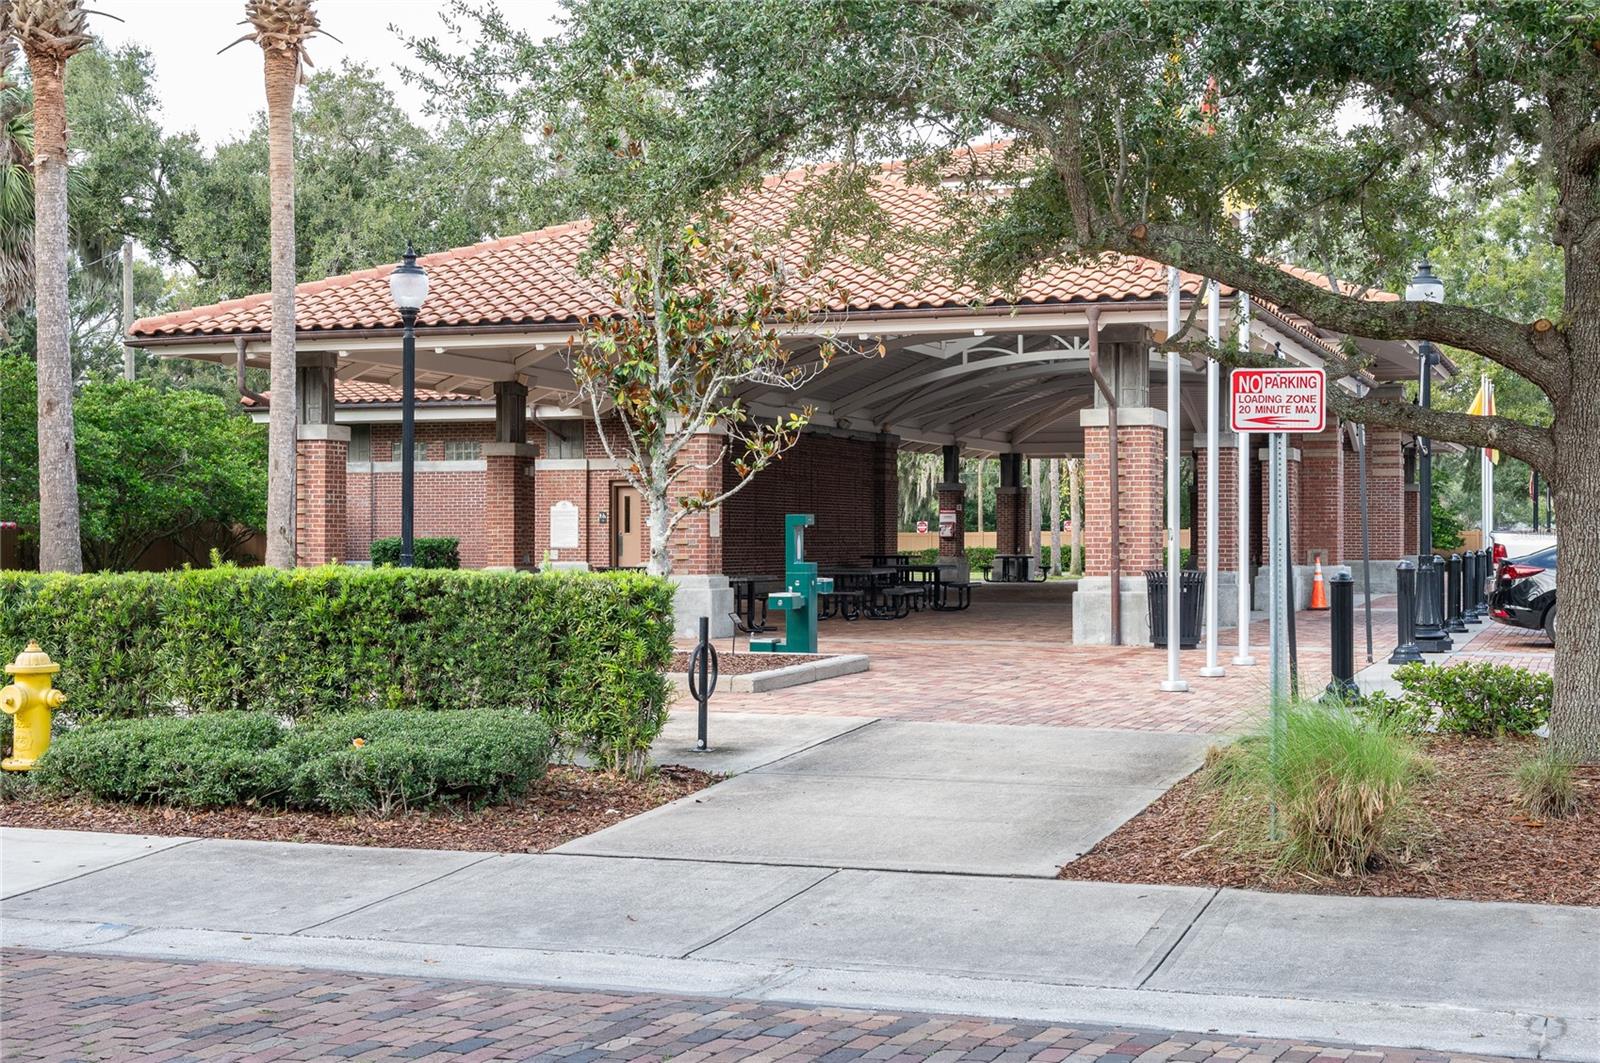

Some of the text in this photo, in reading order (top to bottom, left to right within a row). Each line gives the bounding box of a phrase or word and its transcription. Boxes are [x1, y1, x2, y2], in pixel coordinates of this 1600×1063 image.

[1239, 375, 1316, 393] NO PARKING
[1239, 395, 1316, 403] LOADING ZONE
[1239, 405, 1316, 414] 20 MINUTE MAX
